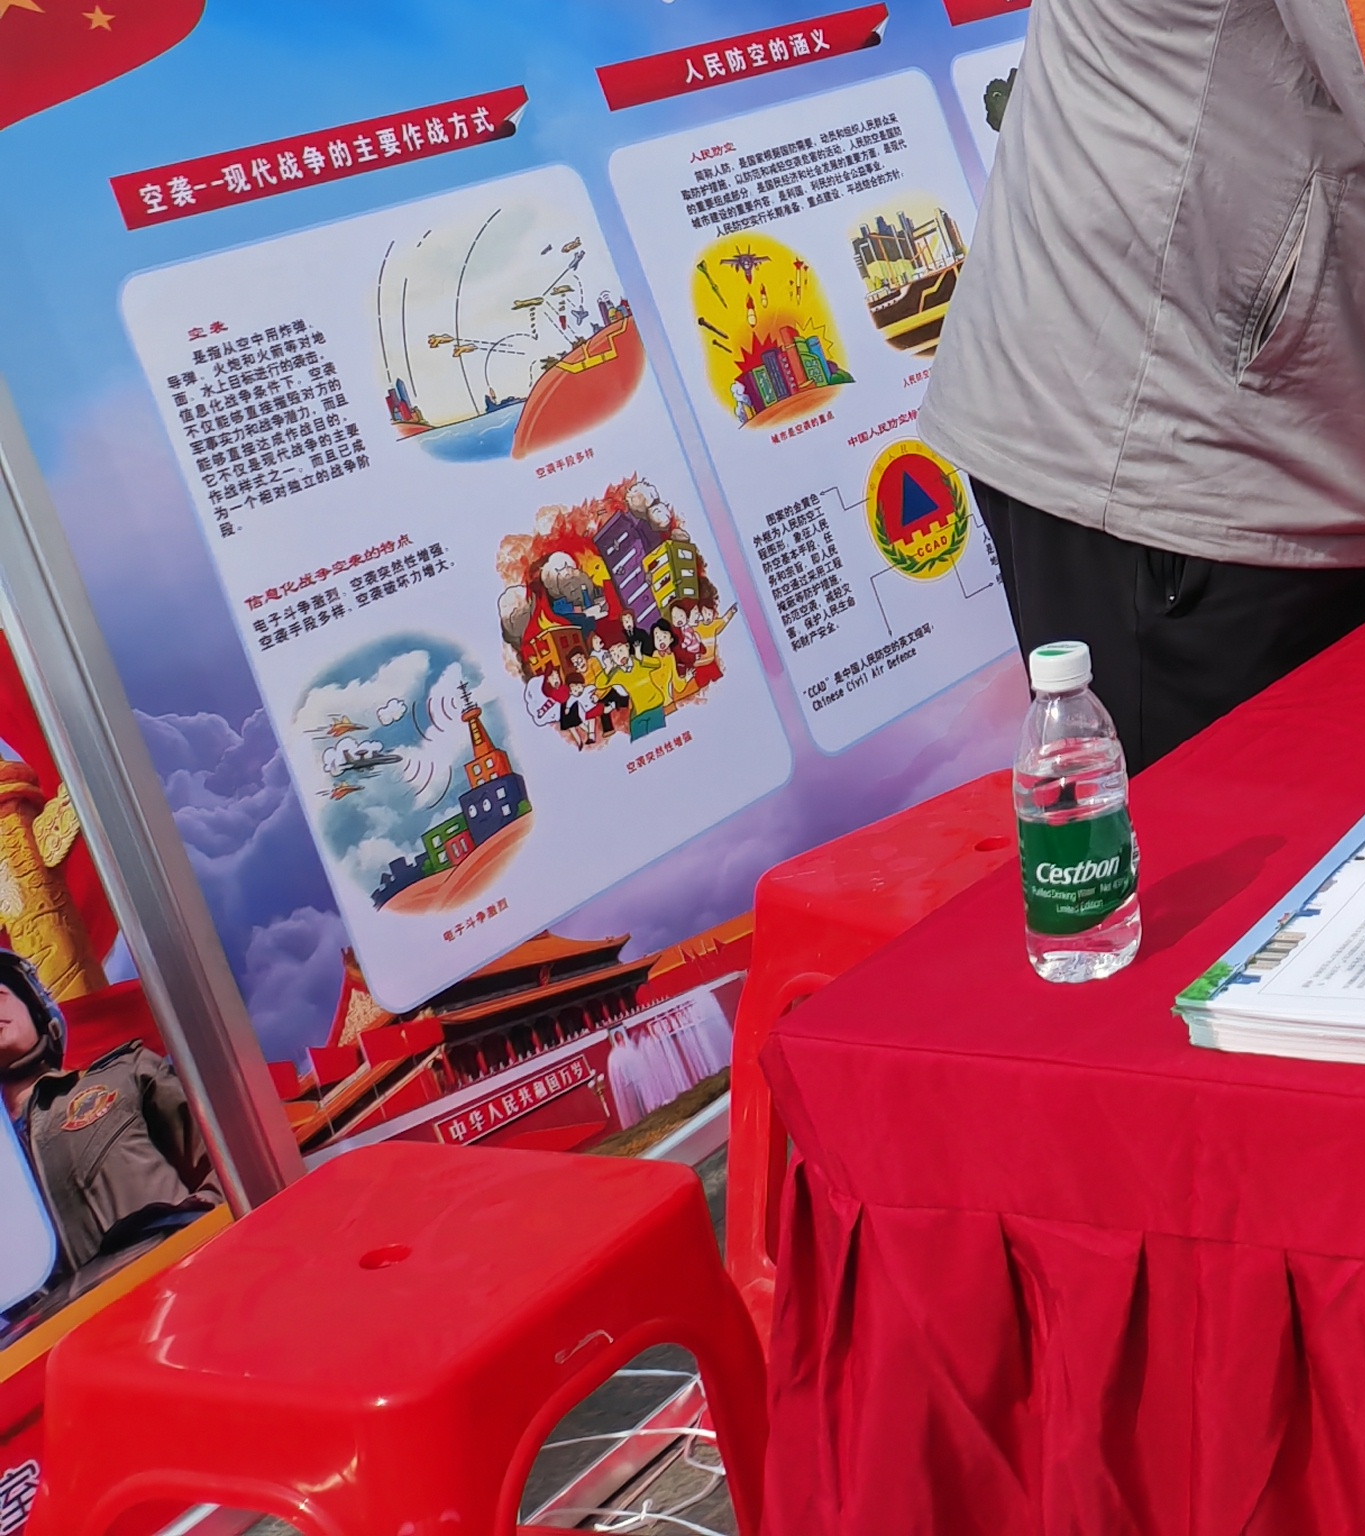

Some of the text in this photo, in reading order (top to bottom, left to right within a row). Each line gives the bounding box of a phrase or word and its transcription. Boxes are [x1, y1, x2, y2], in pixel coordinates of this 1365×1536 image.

[685, 25, 832, 86] 人民防空的涵义
[690, 141, 737, 164] 人民防空
[187, 320, 229, 342] 空袭
[184, 377, 342, 440] 不仅能够直接摧毁对方的
[847, 407, 921, 448] 中国人民防空标
[202, 422, 360, 489] 它不仅是现代战争的主要
[535, 447, 595, 480] 空袭手段多样
[213, 453, 371, 521] 为一个相对独立的战争阶
[243, 532, 414, 612] 信息化战争空袭的特点
[916, 534, 949, 558] CCAD
[812, 647, 917, 711] Chinese Civil Air Defence
[625, 730, 694, 775] 空袭突然性增强
[442, 896, 510, 944] 电子斗争激烈
[448, 1060, 585, 1142] 中华人民共和国万岁
